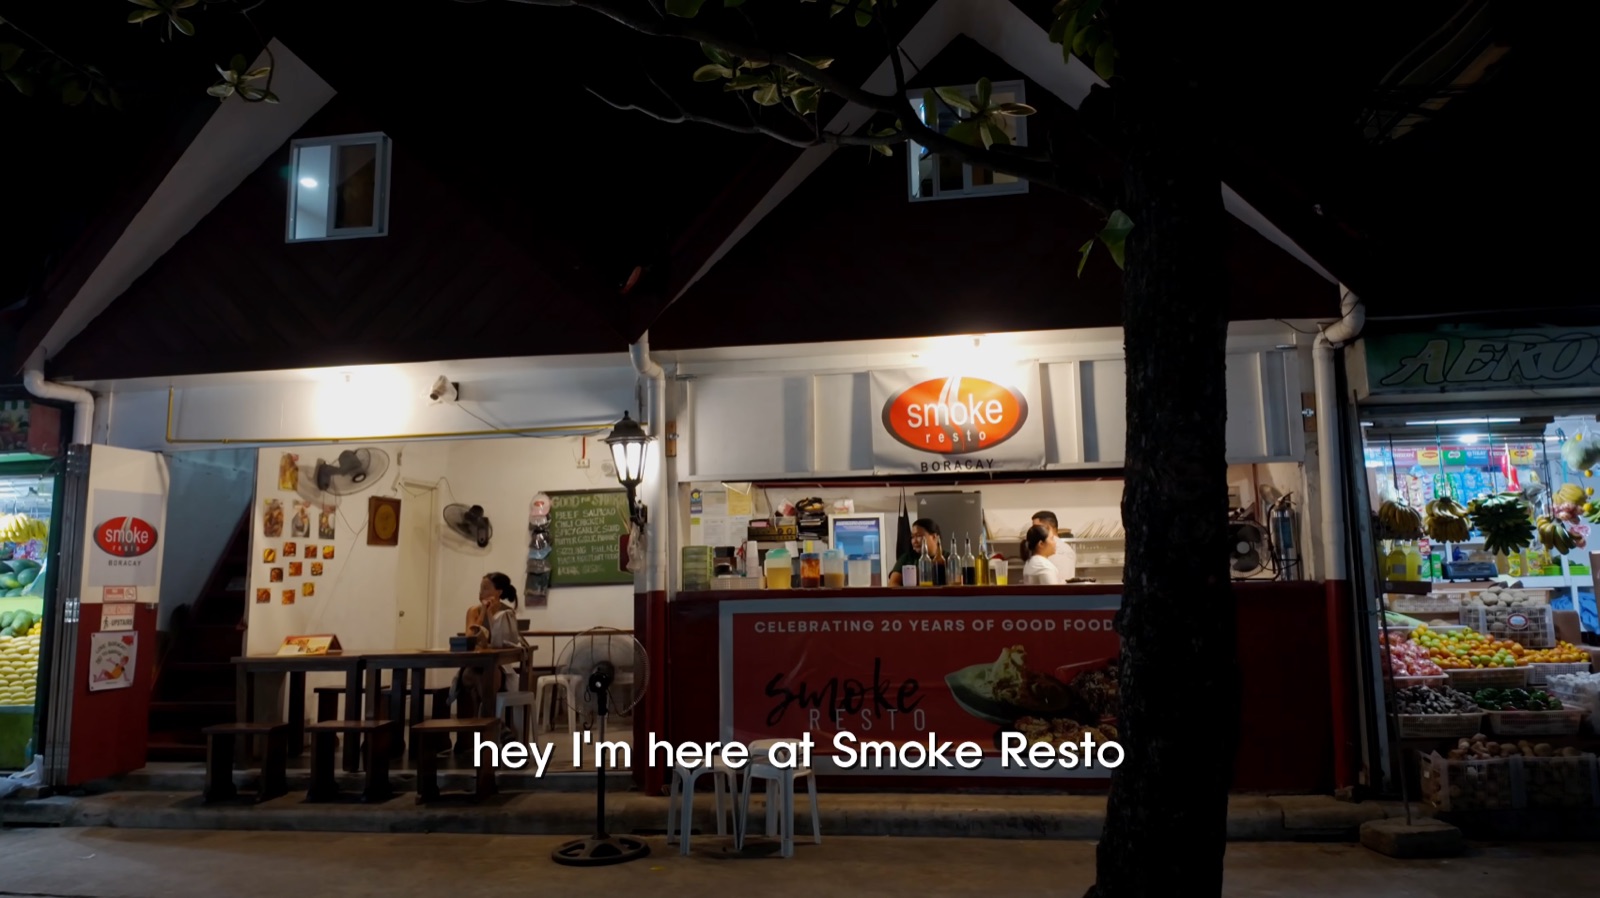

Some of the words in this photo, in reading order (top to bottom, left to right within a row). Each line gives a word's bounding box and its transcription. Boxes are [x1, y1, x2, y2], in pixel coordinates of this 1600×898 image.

[1380, 335, 1600, 386] AERO
[907, 393, 1003, 429] smoke
[926, 430, 986, 443] resto
[920, 458, 994, 473] BORACAY
[105, 526, 149, 544] smoke
[754, 619, 875, 633] CELEBRATING
[881, 620, 902, 632] 20
[909, 619, 965, 632] YEARS
[972, 619, 995, 631] OF
[1001, 619, 1056, 631] GOOD
[1063, 618, 1113, 631] FOOD
[765, 657, 926, 727] smoke
[809, 708, 926, 731] RESTO
